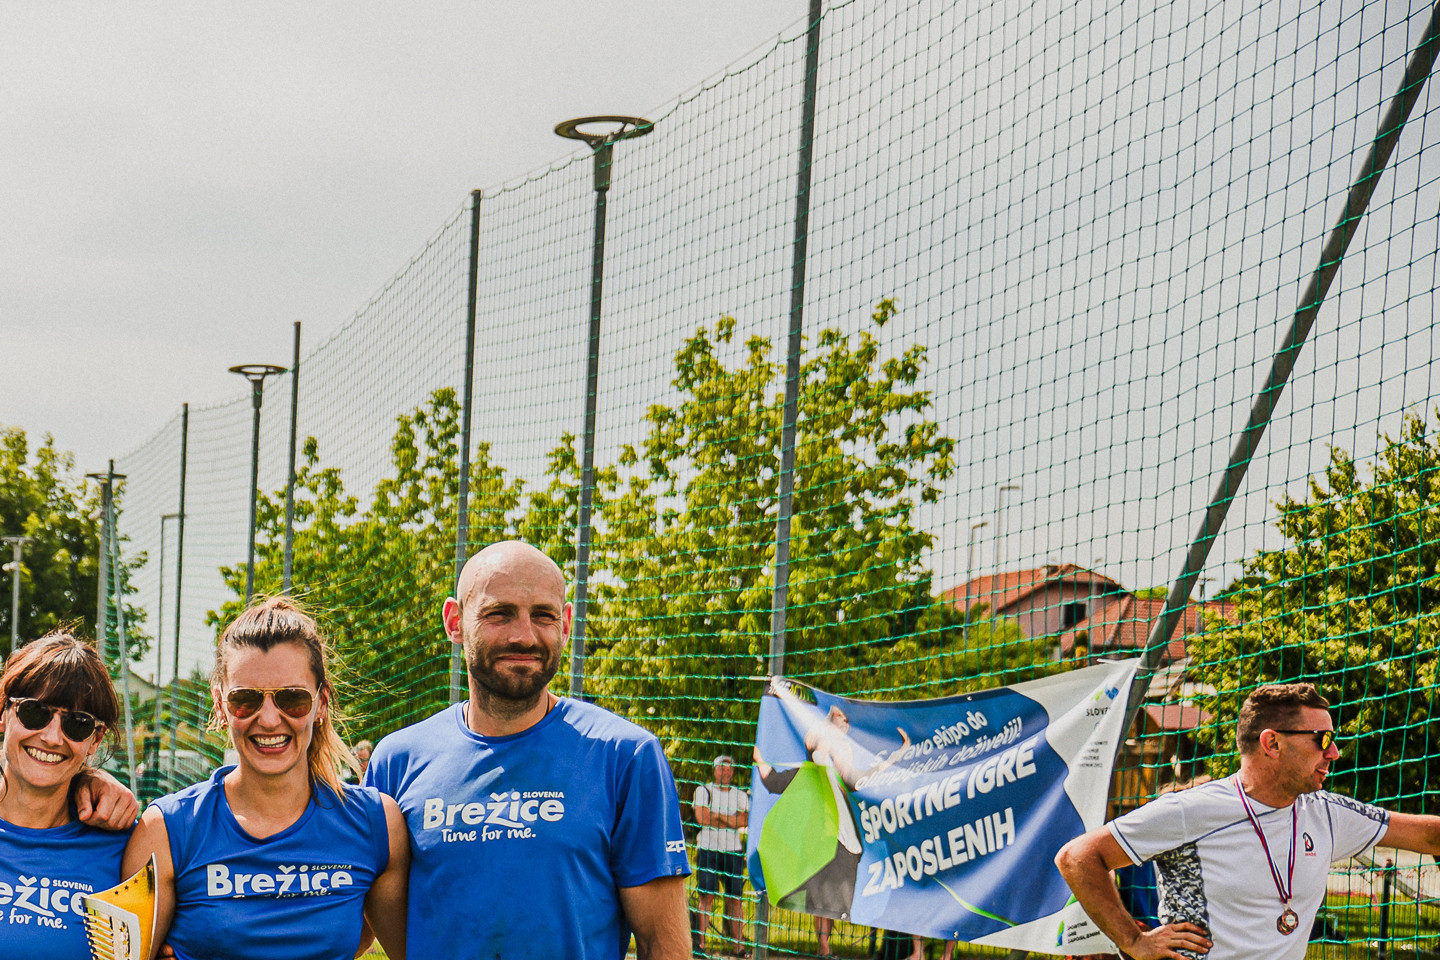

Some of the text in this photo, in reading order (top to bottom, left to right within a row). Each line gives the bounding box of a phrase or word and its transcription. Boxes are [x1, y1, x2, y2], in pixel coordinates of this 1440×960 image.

[933, 721, 970, 750] ekipo
[966, 710, 989, 731] do
[948, 716, 1023, 766] doživetij!
[860, 735, 1041, 845] ŠPORTNE IGRE
[423, 791, 565, 830] Brežice SLOVENIA
[441, 825, 537, 843] Time for me.
[861, 806, 1016, 898] ZAPOSLENIH
[52, 878, 94, 893] SLOVENIA
[206, 864, 354, 897] Brežice
[9, 908, 33, 925] for
[37, 916, 68, 930] me.
